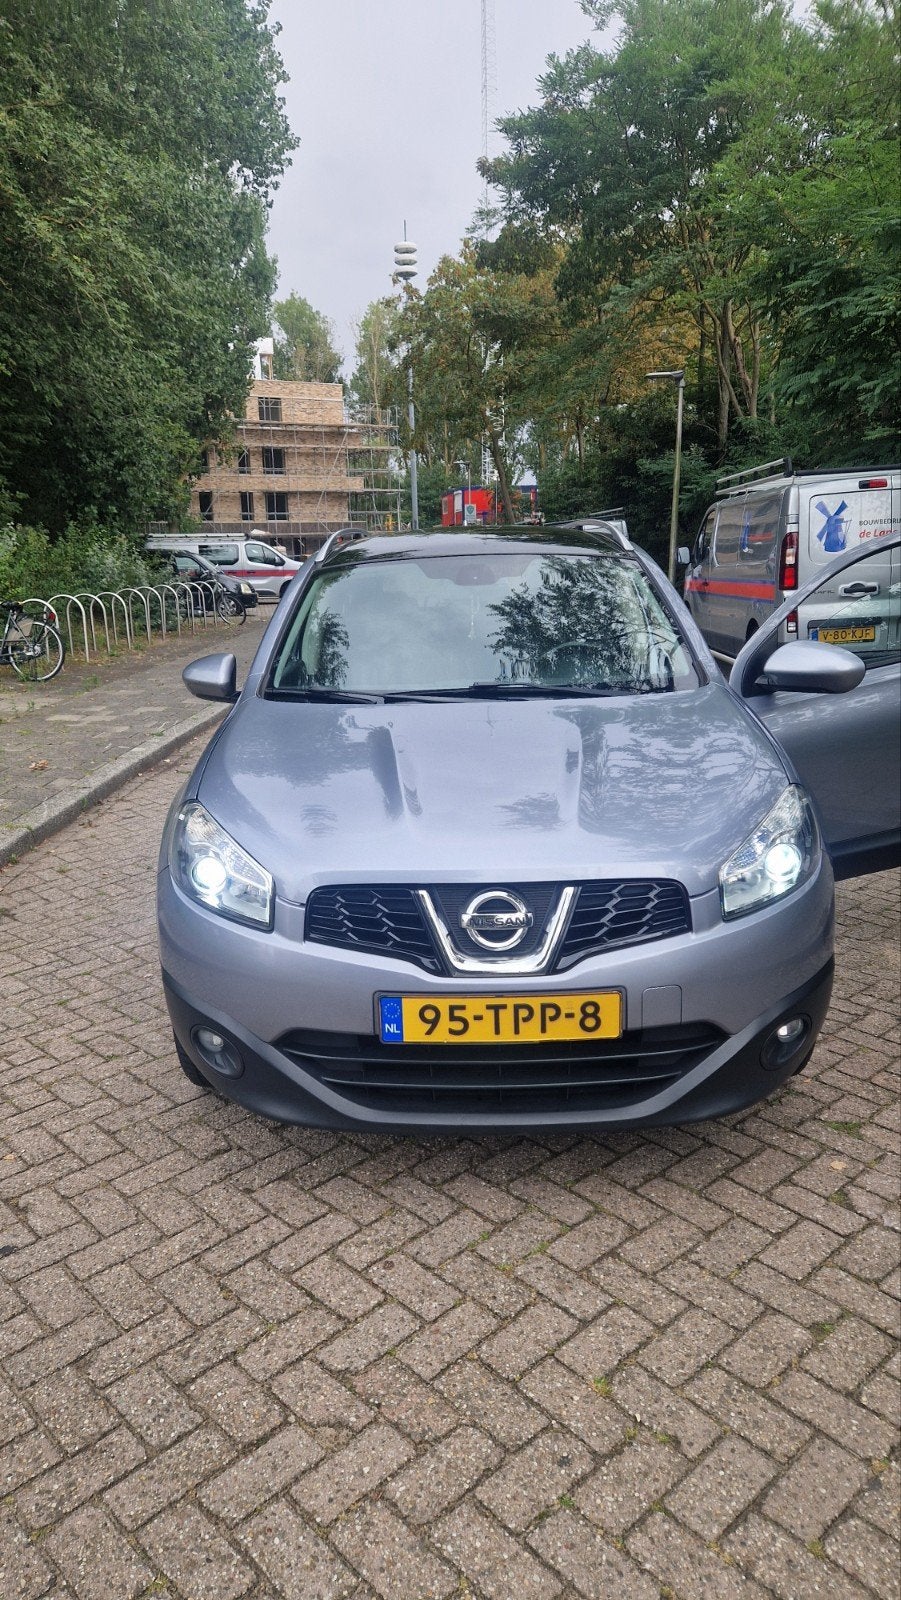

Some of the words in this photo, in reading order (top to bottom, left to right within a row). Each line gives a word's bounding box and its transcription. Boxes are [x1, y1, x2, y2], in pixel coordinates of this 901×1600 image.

[859, 529, 871, 538] de
[823, 628, 871, 641] V-80-KJF
[467, 917, 527, 928] NISSAN
[418, 1000, 602, 1036] 95-TPP-8
[385, 1023, 401, 1034] NL
